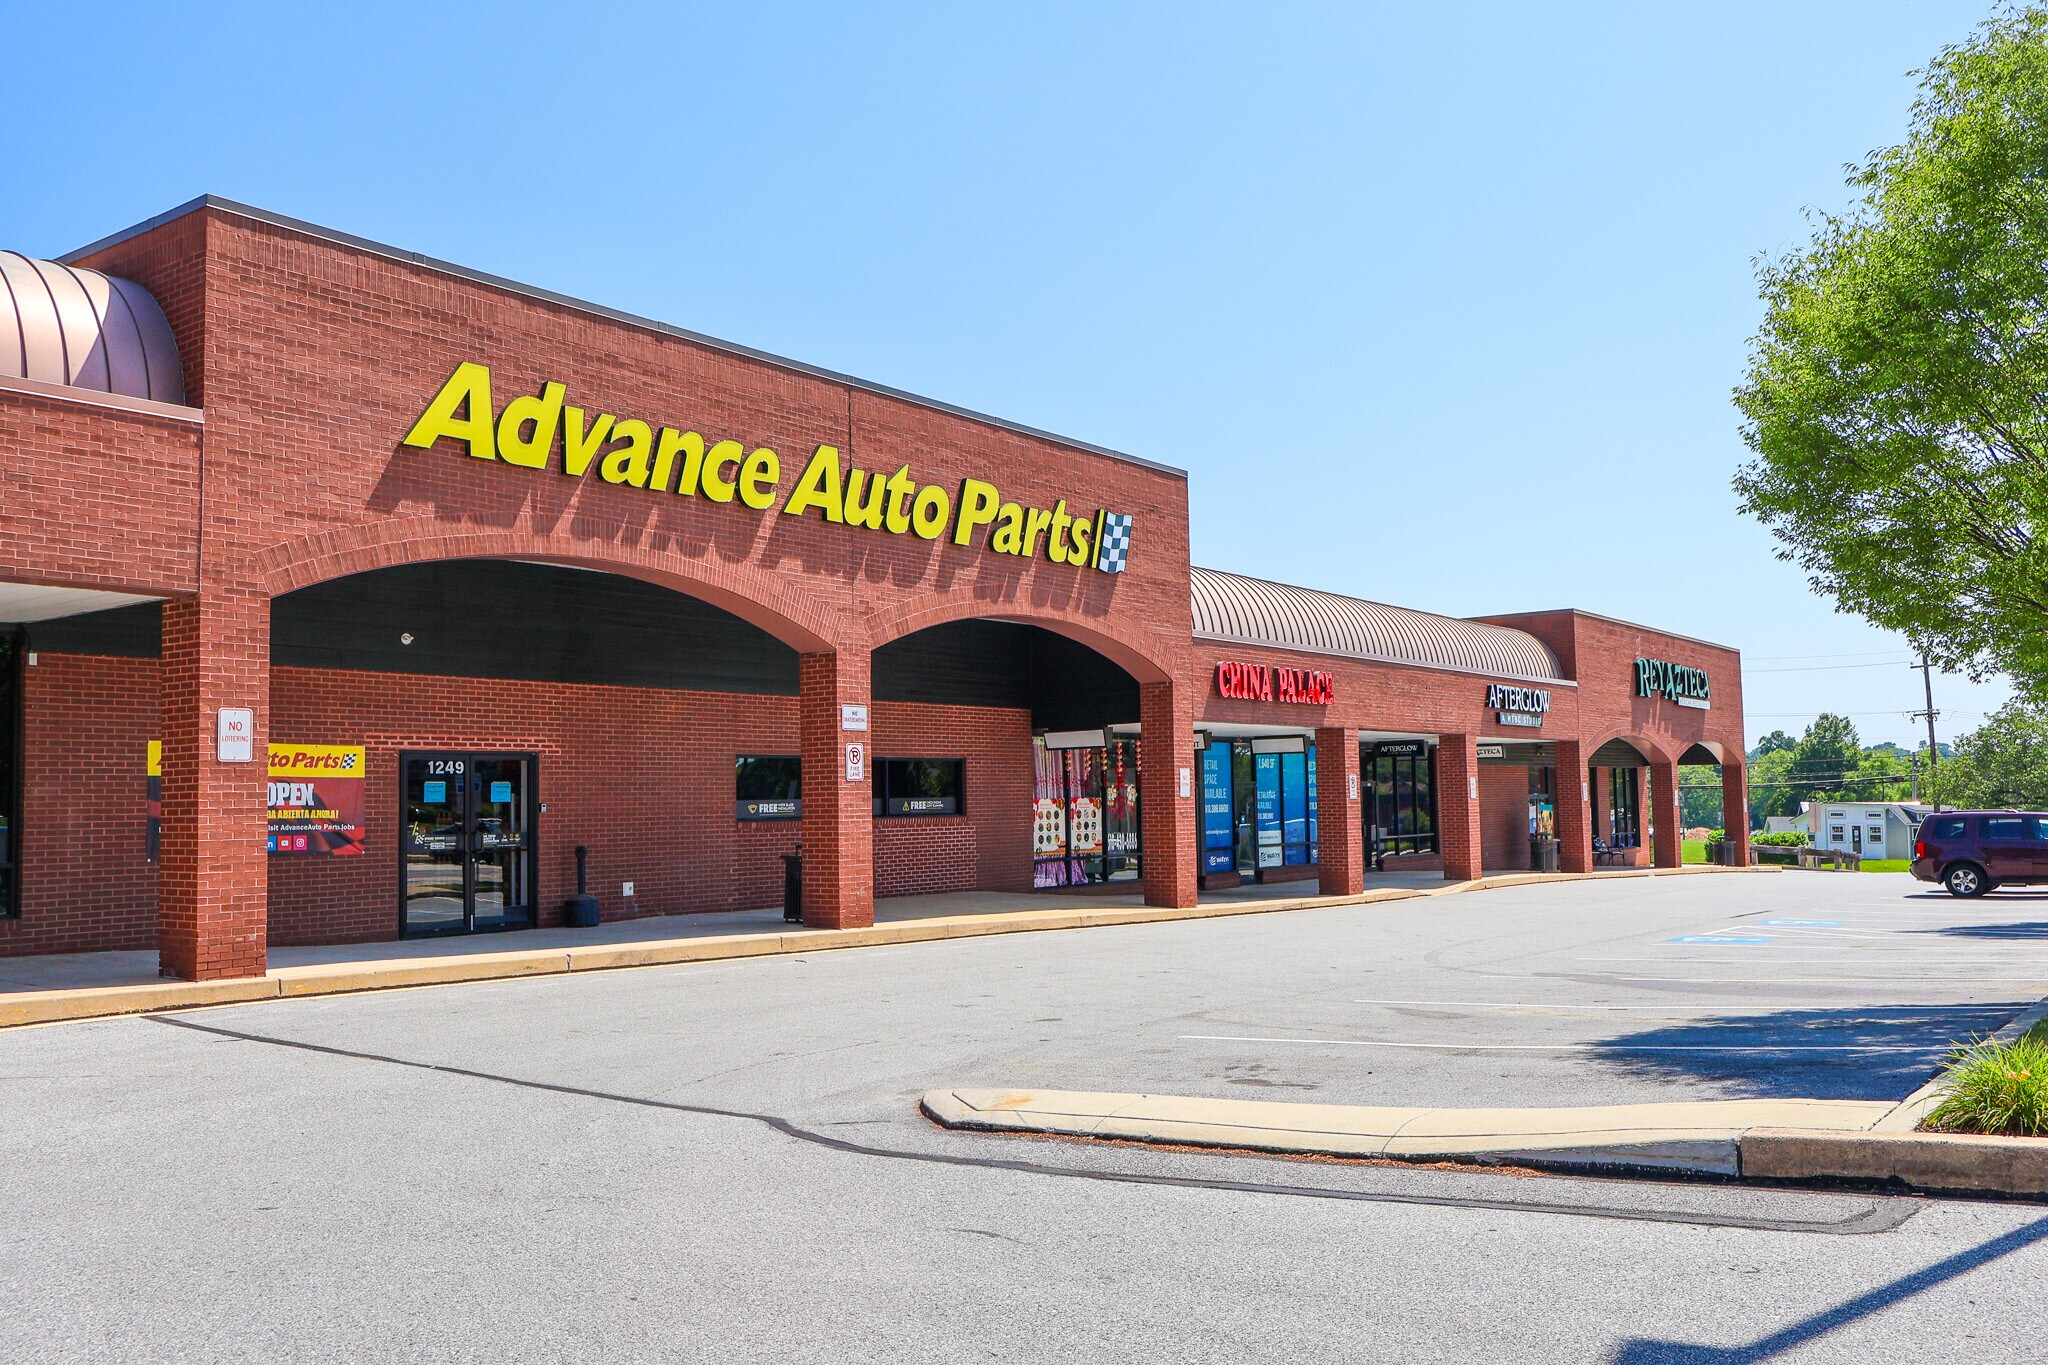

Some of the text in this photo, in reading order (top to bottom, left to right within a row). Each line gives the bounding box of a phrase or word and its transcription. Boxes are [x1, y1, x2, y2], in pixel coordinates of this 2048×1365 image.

[403, 361, 1092, 567] Advance Auto Parts
[1216, 661, 1335, 705] CHINA PALACE
[1662, 662, 1711, 701] AZTECA
[1488, 683, 1551, 713] AFTERGLOW
[1523, 716, 1542, 725] STUDIO
[228, 721, 243, 732] NO
[221, 735, 249, 743] LOITERING
[1380, 744, 1418, 752] AFTERGLOW
[1477, 748, 1501, 756] ZTECA
[268, 752, 340, 769] to Parts
[1204, 759, 1218, 770] RETAIL
[427, 760, 465, 775] 1249
[1204, 773, 1217, 785] SPACE
[267, 782, 315, 807] OPEN
[1204, 788, 1227, 799] AVAILABLE
[758, 803, 778, 814] FREE
[910, 800, 927, 810] FREE
[277, 809, 310, 819] ABIERTA
[310, 809, 339, 819] AHORA!
[268, 823, 279, 831] isit
